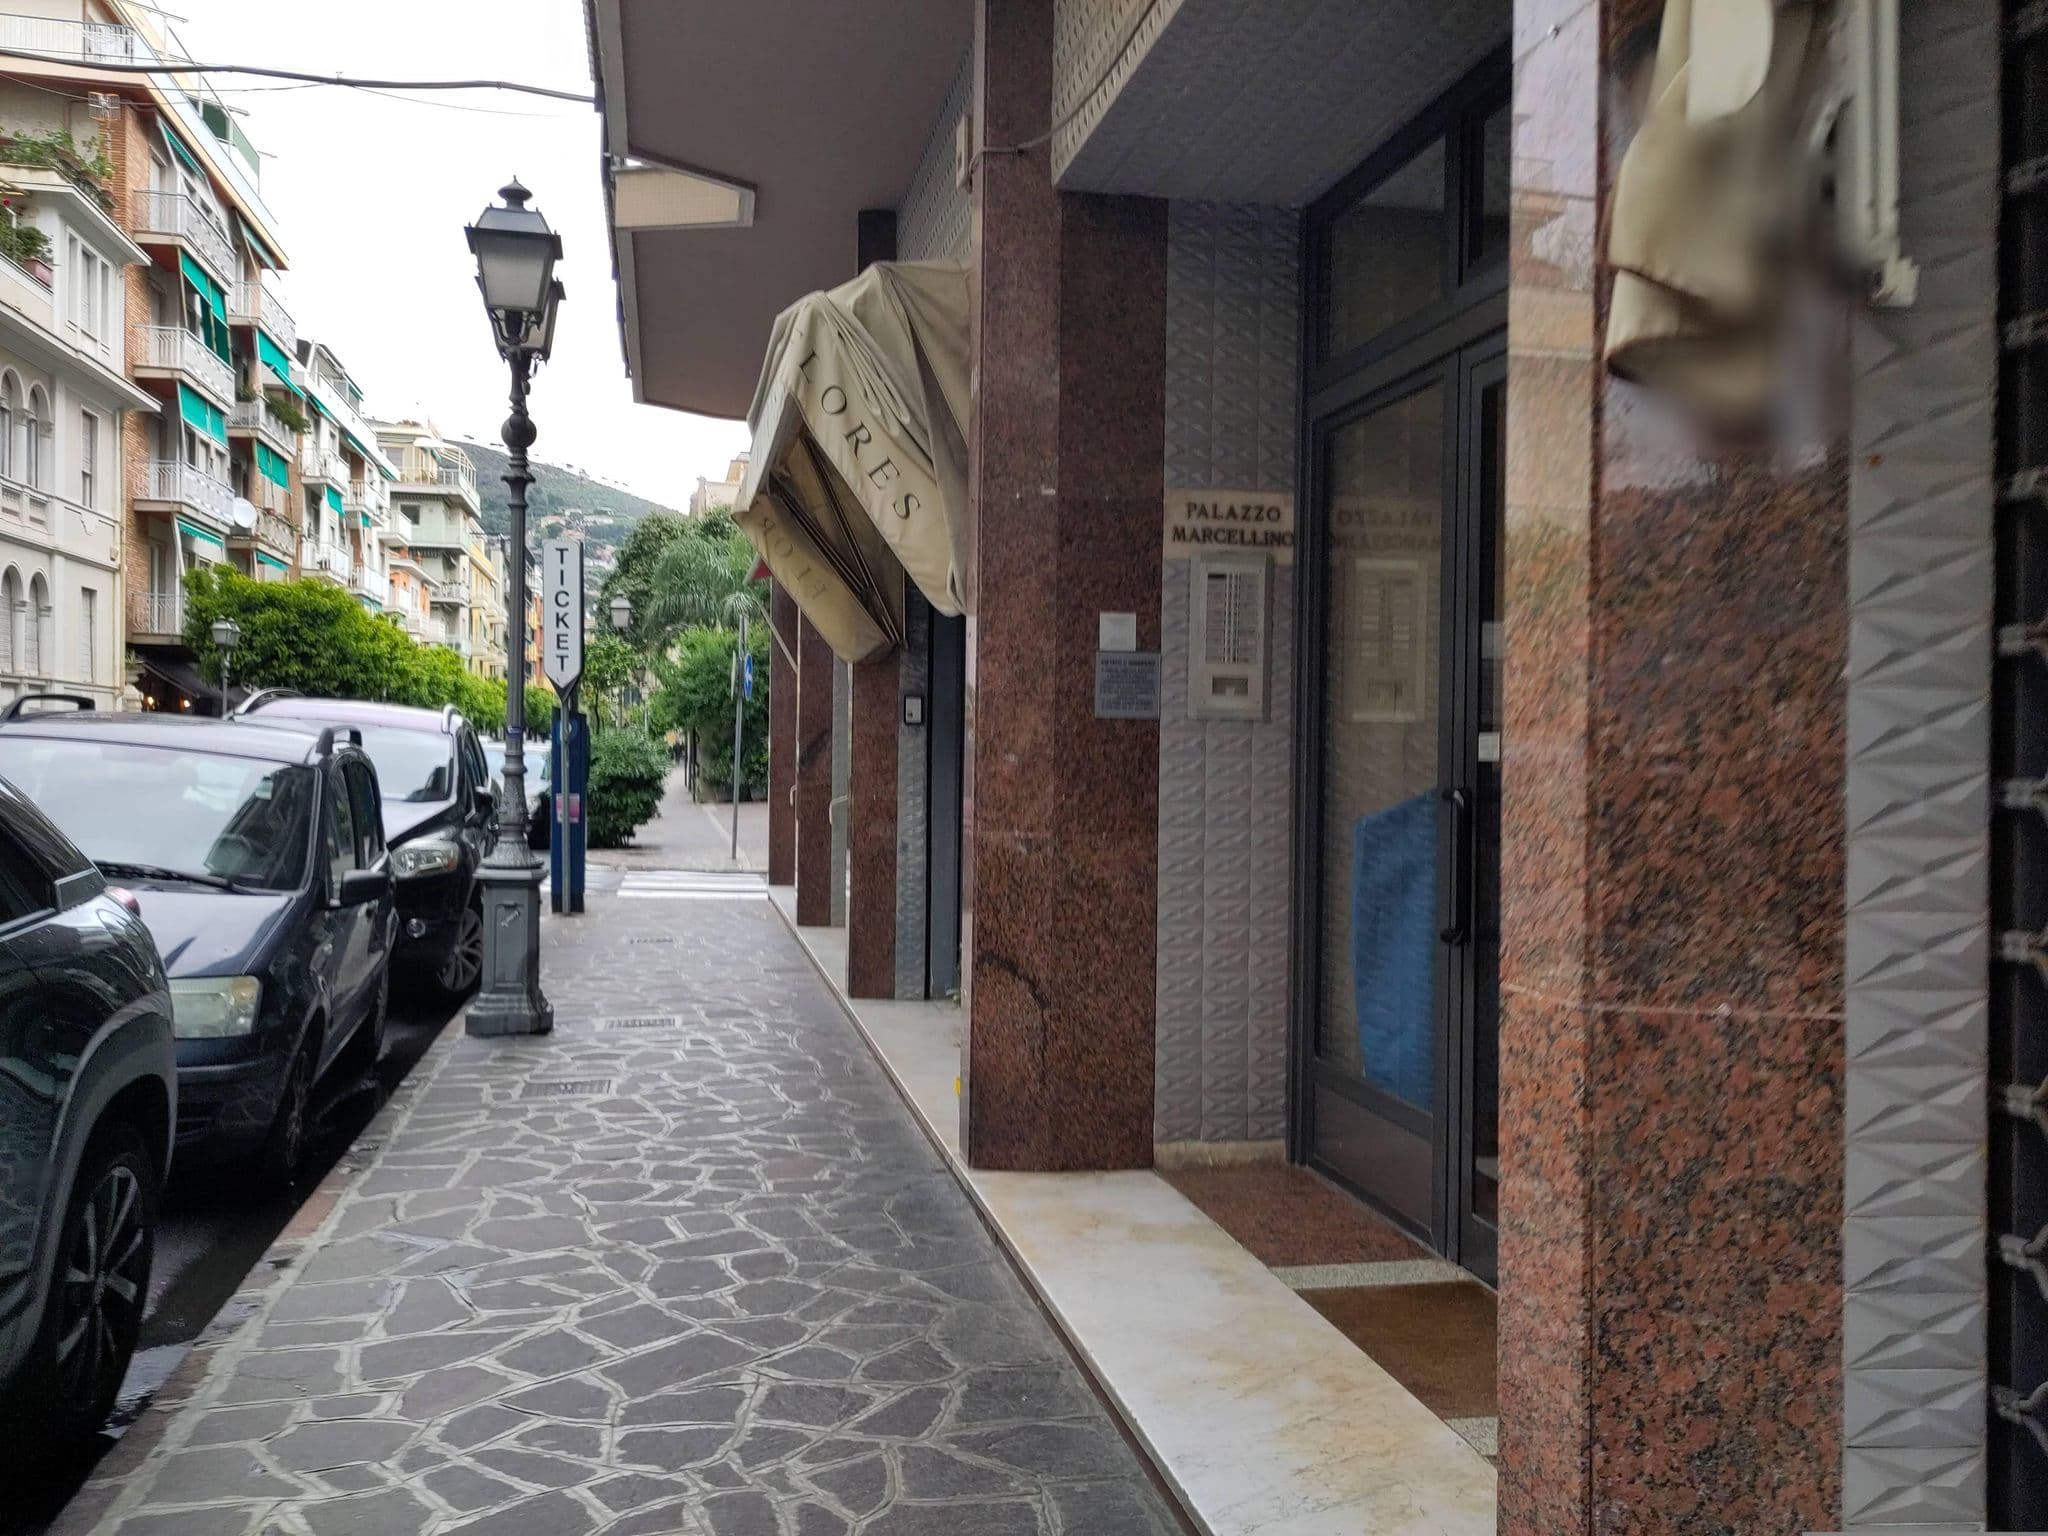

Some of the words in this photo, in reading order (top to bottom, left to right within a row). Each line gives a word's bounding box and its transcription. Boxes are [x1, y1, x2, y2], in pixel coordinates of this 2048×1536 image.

[797, 340, 921, 521] LORES
[1172, 525, 1294, 546] MARCELLINO
[1186, 501, 1281, 523] PALAZZO
[555, 547, 570, 672] TICKET
